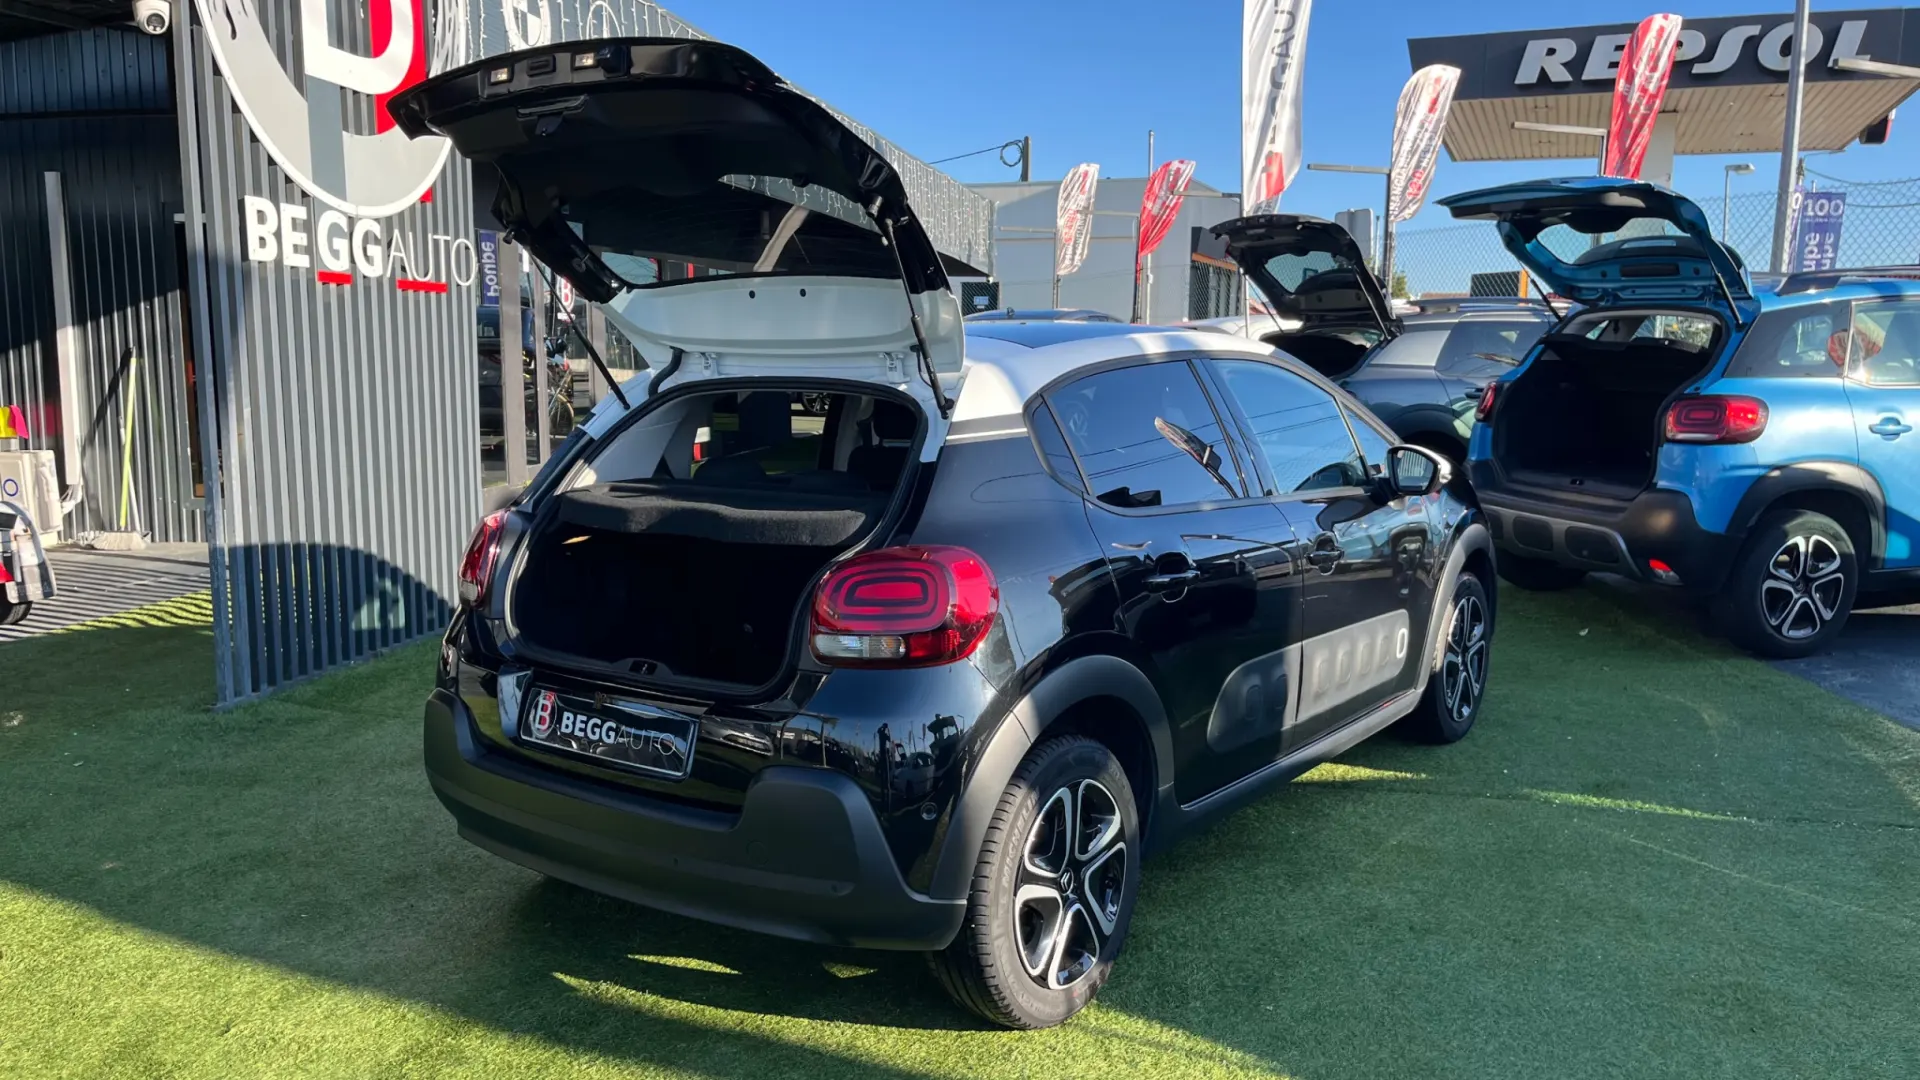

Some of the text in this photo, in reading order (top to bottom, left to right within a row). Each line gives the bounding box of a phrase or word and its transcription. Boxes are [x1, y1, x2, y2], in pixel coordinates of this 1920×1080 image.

[1803, 198, 1844, 217] 100
[1802, 232, 1822, 273] upe
[561, 711, 676, 756] BEGGAUTO
